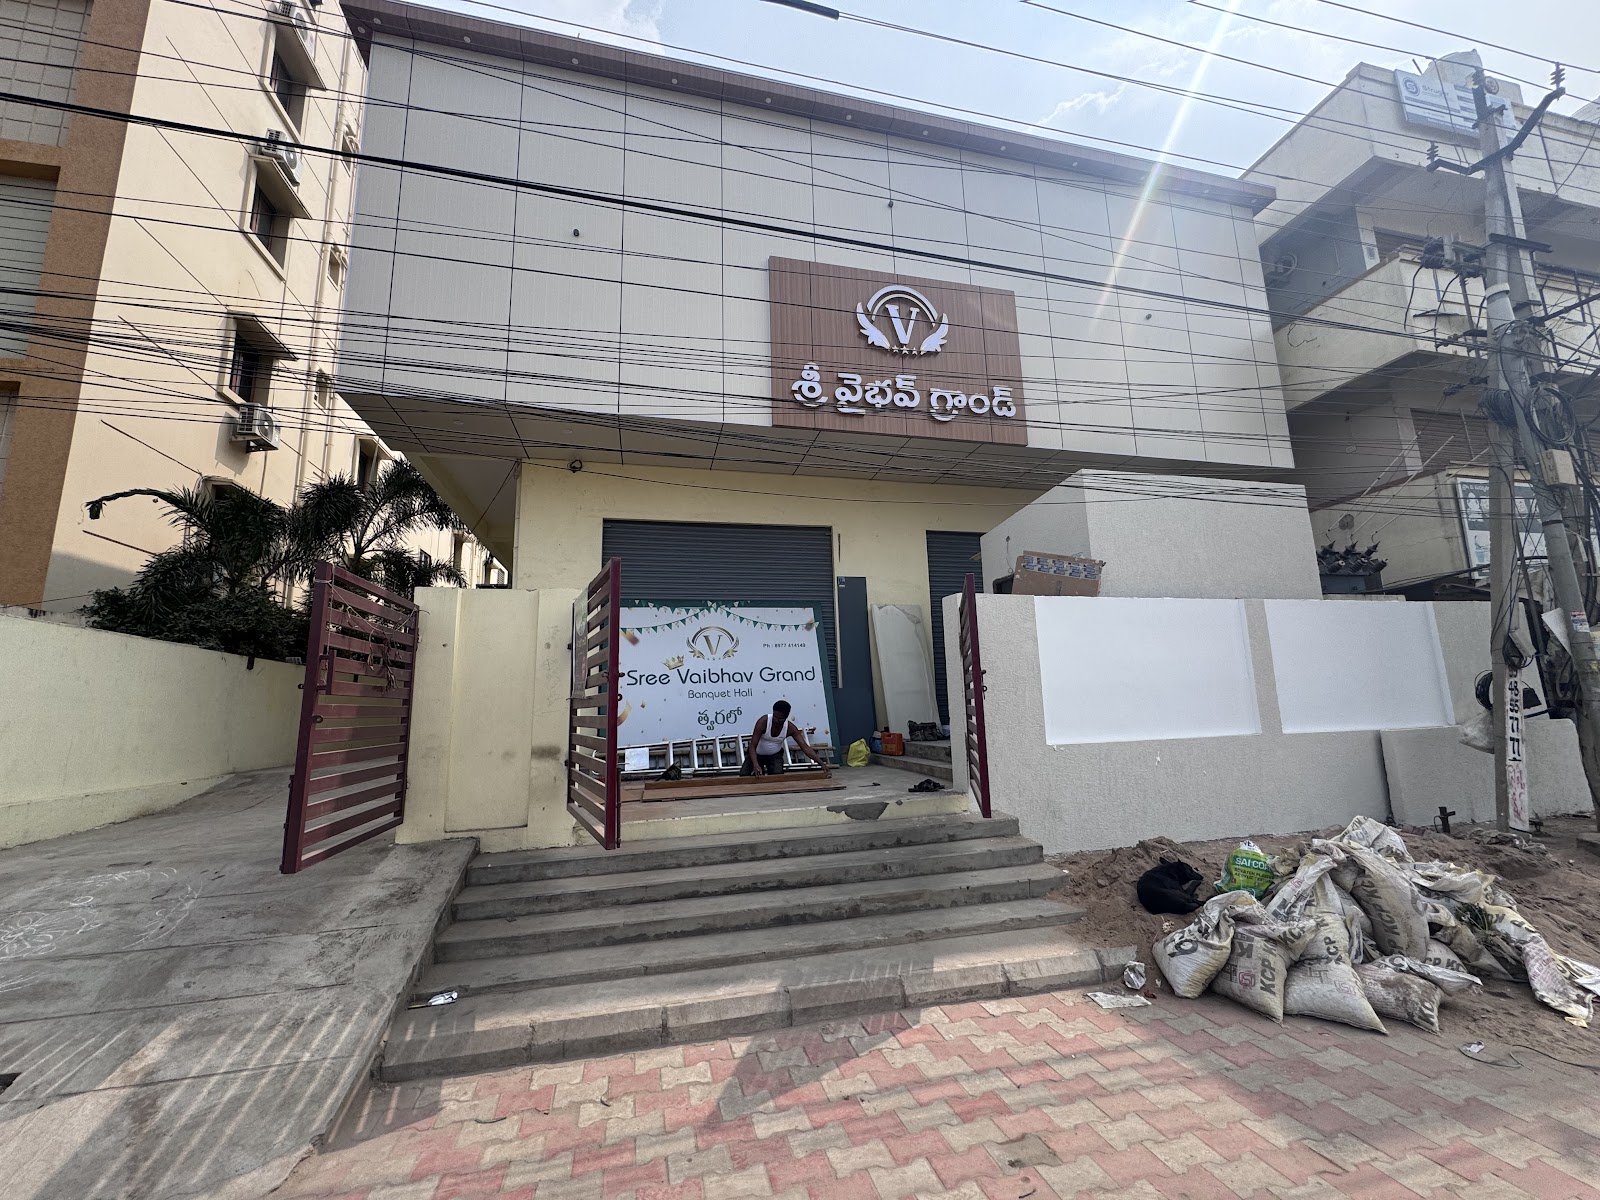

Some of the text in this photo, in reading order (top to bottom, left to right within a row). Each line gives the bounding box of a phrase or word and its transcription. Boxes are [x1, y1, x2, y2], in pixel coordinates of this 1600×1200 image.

[791, 362, 1017, 422] శ్రీ వైభవ్ గ్రాండ్
[626, 666, 816, 686] Sree Vaibhav Grand
[687, 688, 753, 700] Banquet Hall
[697, 706, 743, 730] త్వరలో
[1235, 857, 1251, 867] SAI
[1260, 958, 1276, 996] KCP
